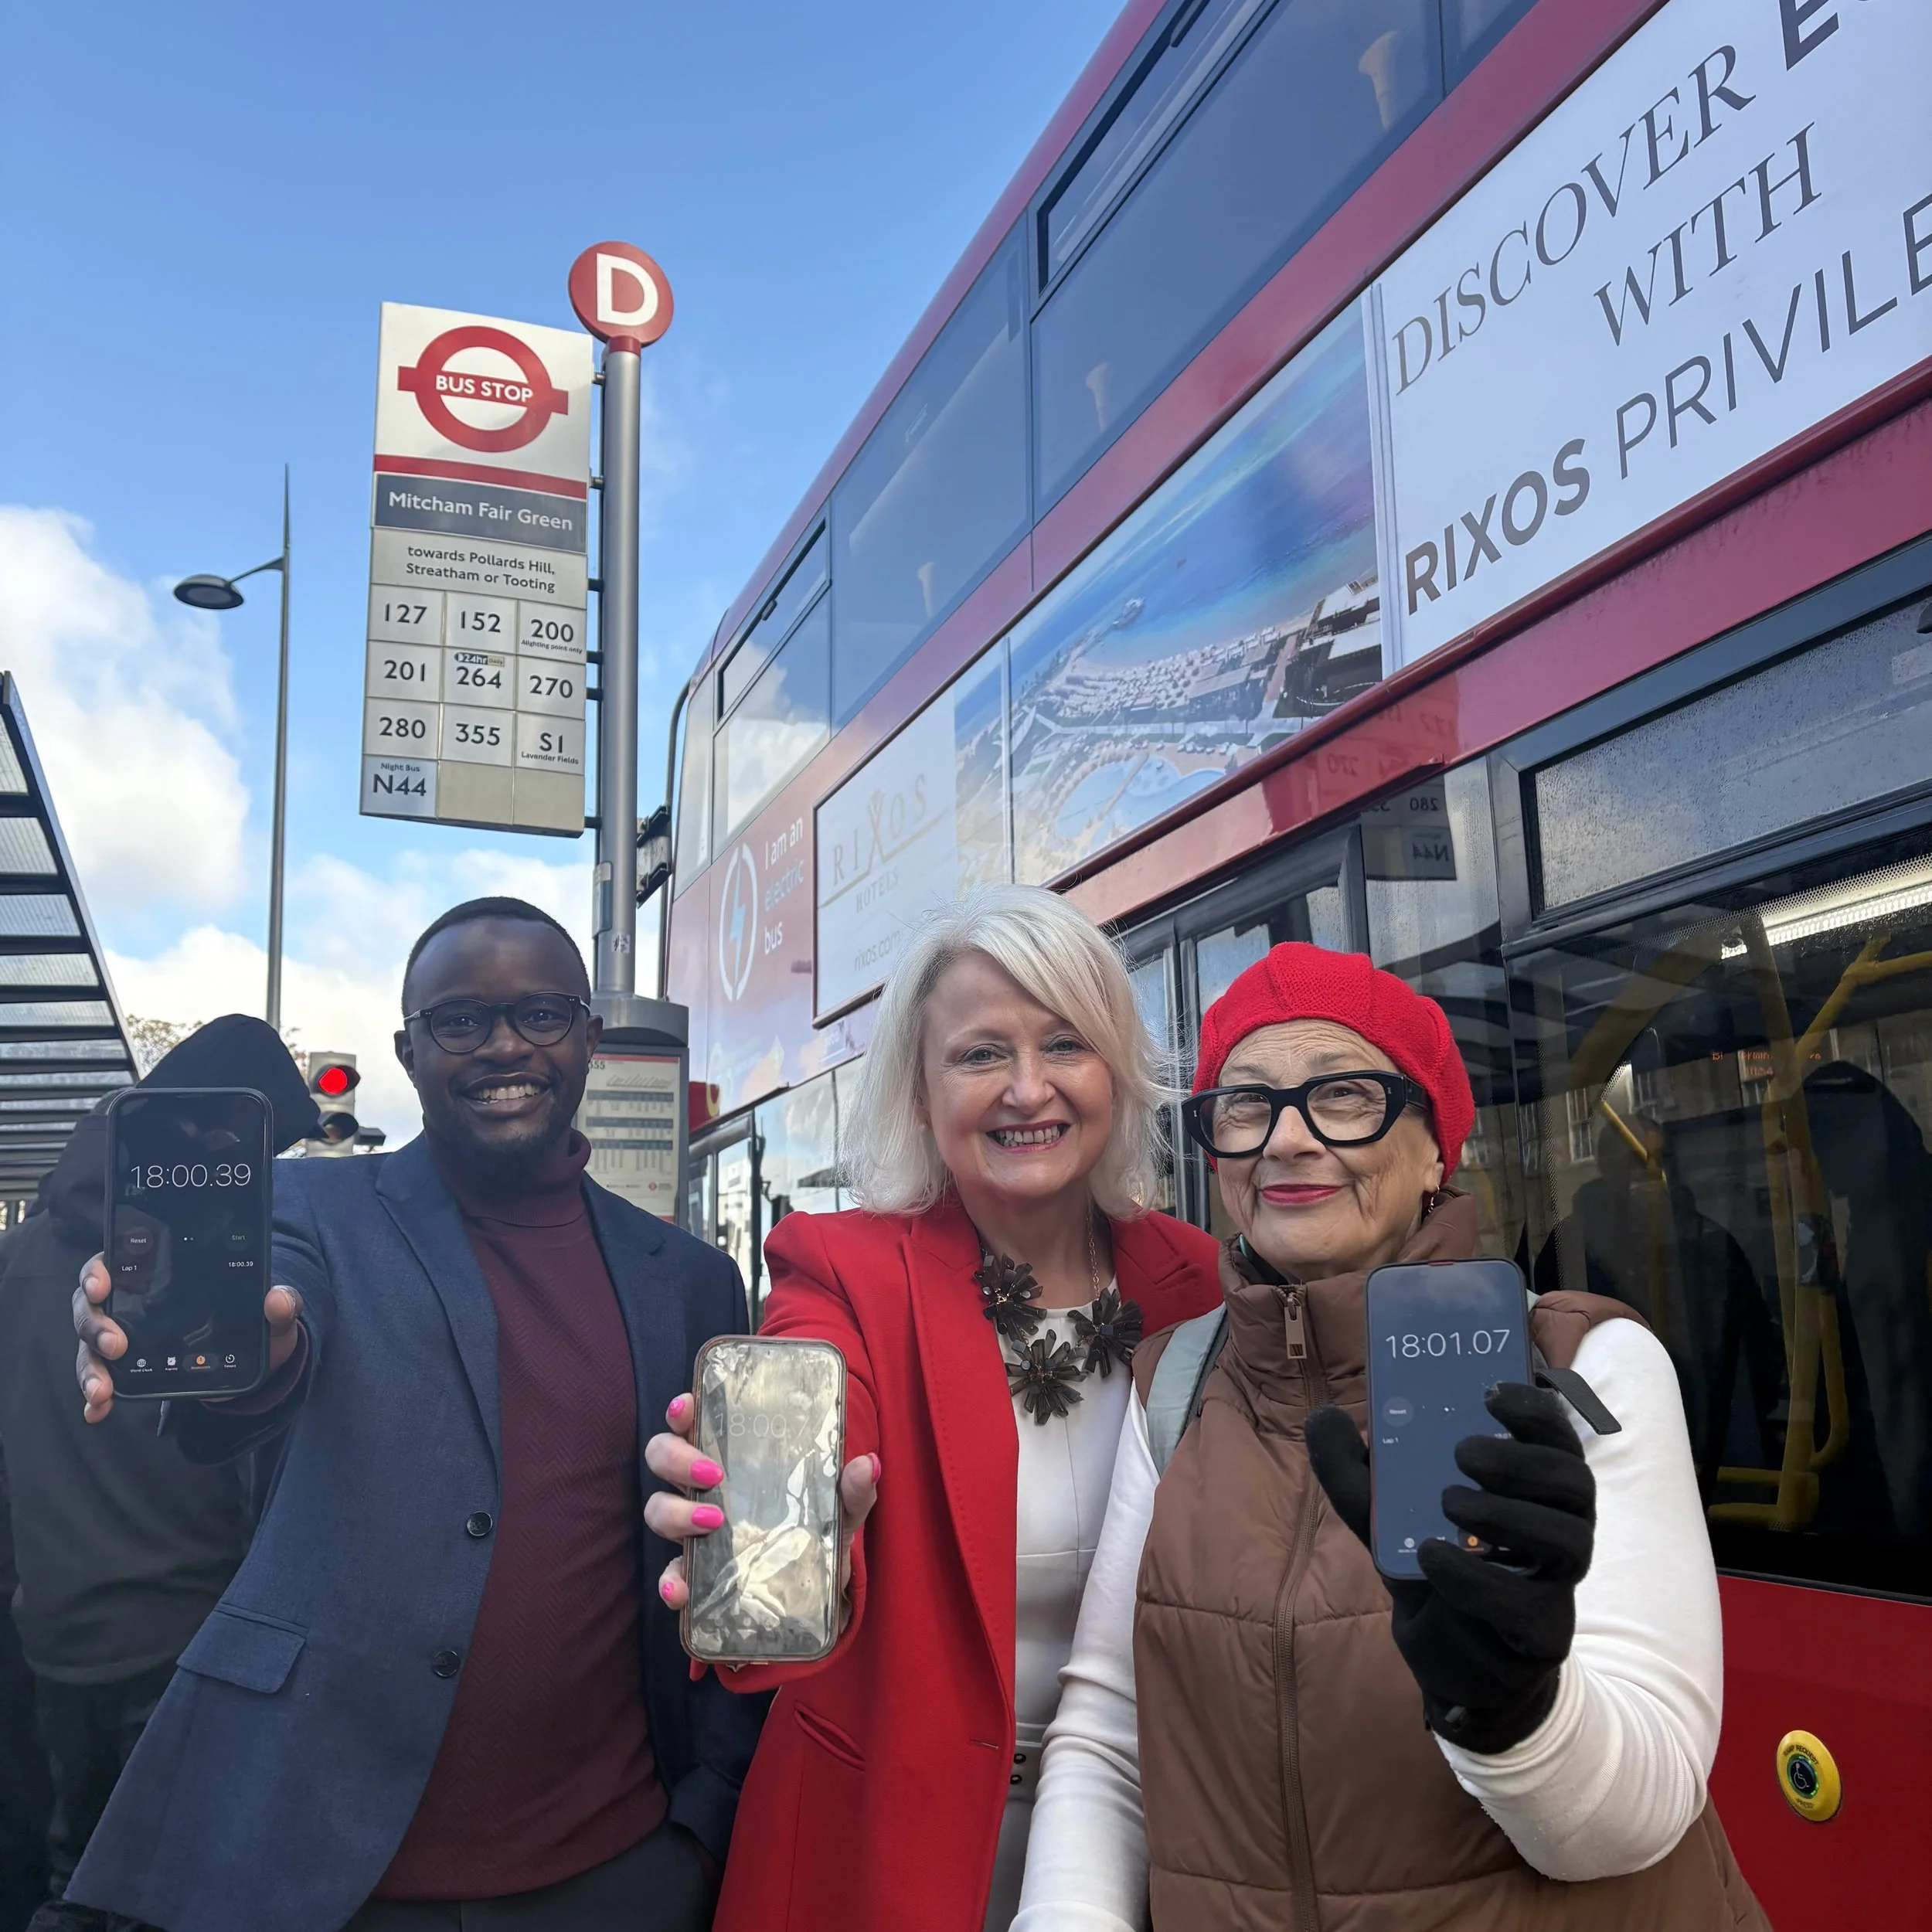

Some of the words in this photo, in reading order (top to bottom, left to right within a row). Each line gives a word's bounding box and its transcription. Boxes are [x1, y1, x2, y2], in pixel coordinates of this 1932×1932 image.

[1393, 45, 1756, 396] DISCOVER
[1594, 122, 1821, 347] WITH
[596, 252, 658, 326] D
[435, 375, 475, 394] BUS
[481, 382, 533, 403] STOP
[1405, 437, 1590, 616] RIXOS
[1616, 192, 1932, 481] PRIVILE
[388, 491, 473, 516] Mitcham
[478, 502, 512, 522] Fair
[517, 509, 573, 531] Green
[407, 546, 465, 562] towards
[469, 551, 525, 570] Pollards
[529, 560, 555, 575] Hill,
[406, 563, 479, 582] Streatham
[484, 573, 499, 583] or
[503, 574, 556, 594] Tooting
[384, 603, 427, 624] 127
[460, 611, 501, 633] 152
[530, 618, 574, 643] 200
[521, 638, 549, 650] Alighting
[550, 643, 568, 652] point
[383, 659, 426, 682] 201
[464, 653, 488, 665] 24hr
[456, 665, 502, 689] 264
[529, 675, 573, 699] 270
[379, 716, 426, 740] 280
[455, 723, 501, 747] 355
[539, 732, 564, 754] S1
[380, 761, 404, 773] Night
[405, 764, 421, 772] Bus
[521, 751, 556, 762] Lavender
[556, 755, 580, 765] Fields
[372, 773, 427, 797] N44
[765, 840, 770, 870] I
[770, 832, 787, 866] am
[790, 816, 804, 848] an
[832, 773, 927, 887] RIXOS
[764, 859, 805, 913] electric
[855, 865, 900, 913] HOTELS
[764, 920, 784, 957] bus
[854, 930, 903, 974] rixos.com
[131, 1163, 251, 1189] 18:00.39
[1386, 1328, 1511, 1359] 18:01.07
